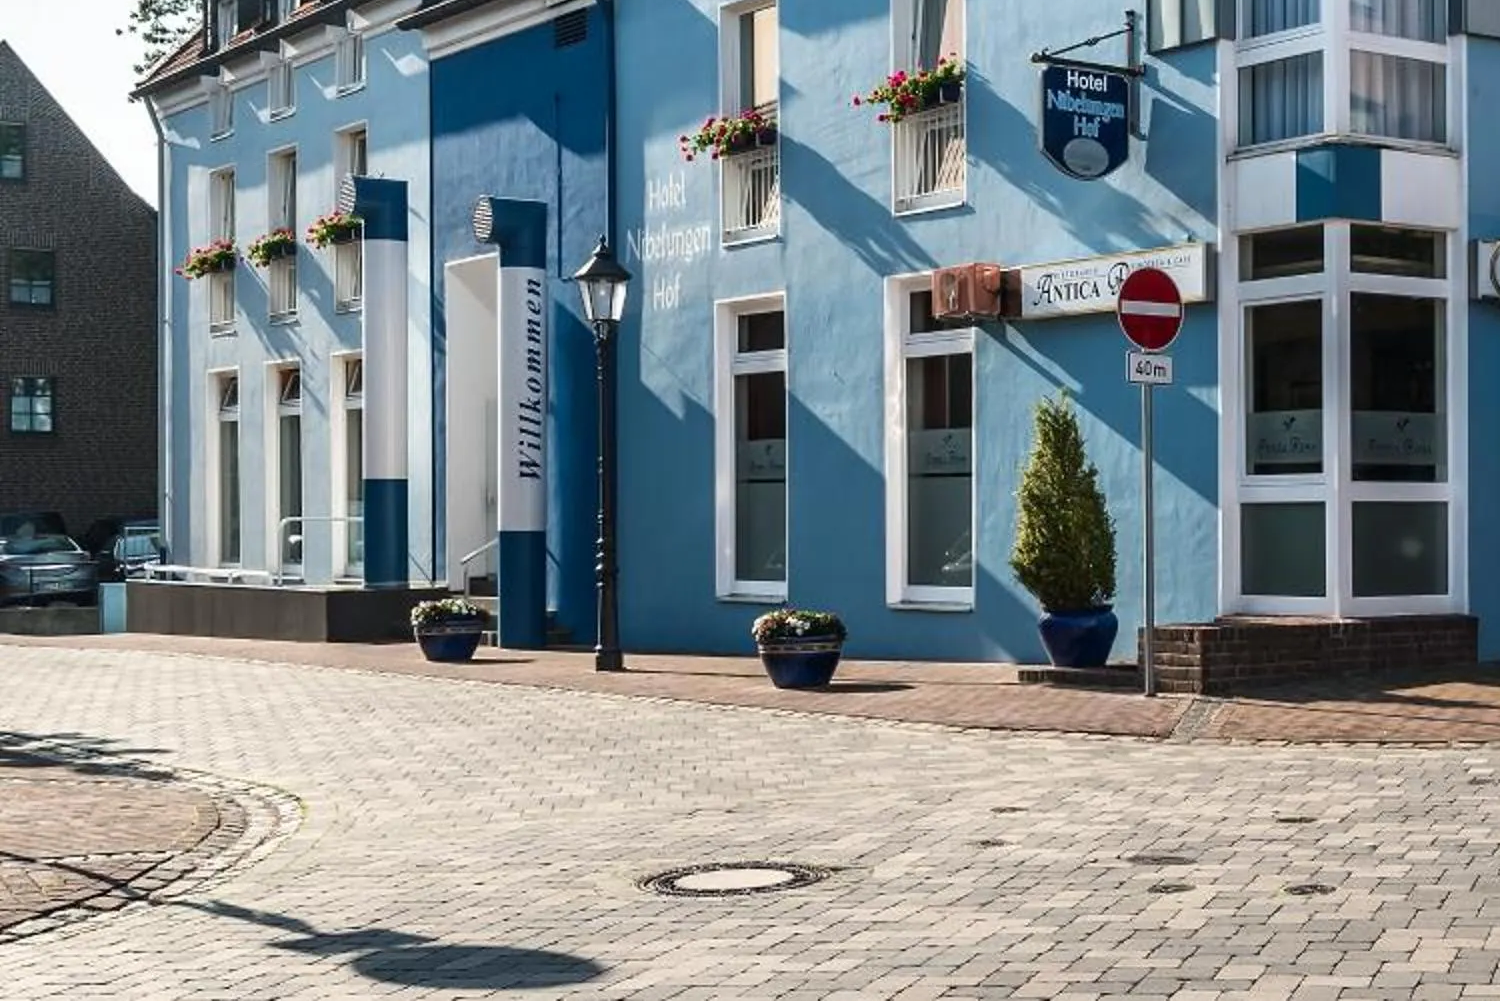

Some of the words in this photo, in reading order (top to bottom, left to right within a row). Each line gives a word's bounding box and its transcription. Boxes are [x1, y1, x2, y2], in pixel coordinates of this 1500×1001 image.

[1067, 70, 1107, 92] Hotel
[1047, 88, 1125, 123] Nibelungen
[1073, 115, 1101, 138] Hof
[649, 170, 687, 212] Hotel
[626, 221, 712, 263] Nibelungen
[653, 271, 682, 311] Hof
[1033, 274, 1101, 306] ANTICA
[518, 278, 542, 480] Willkommen
